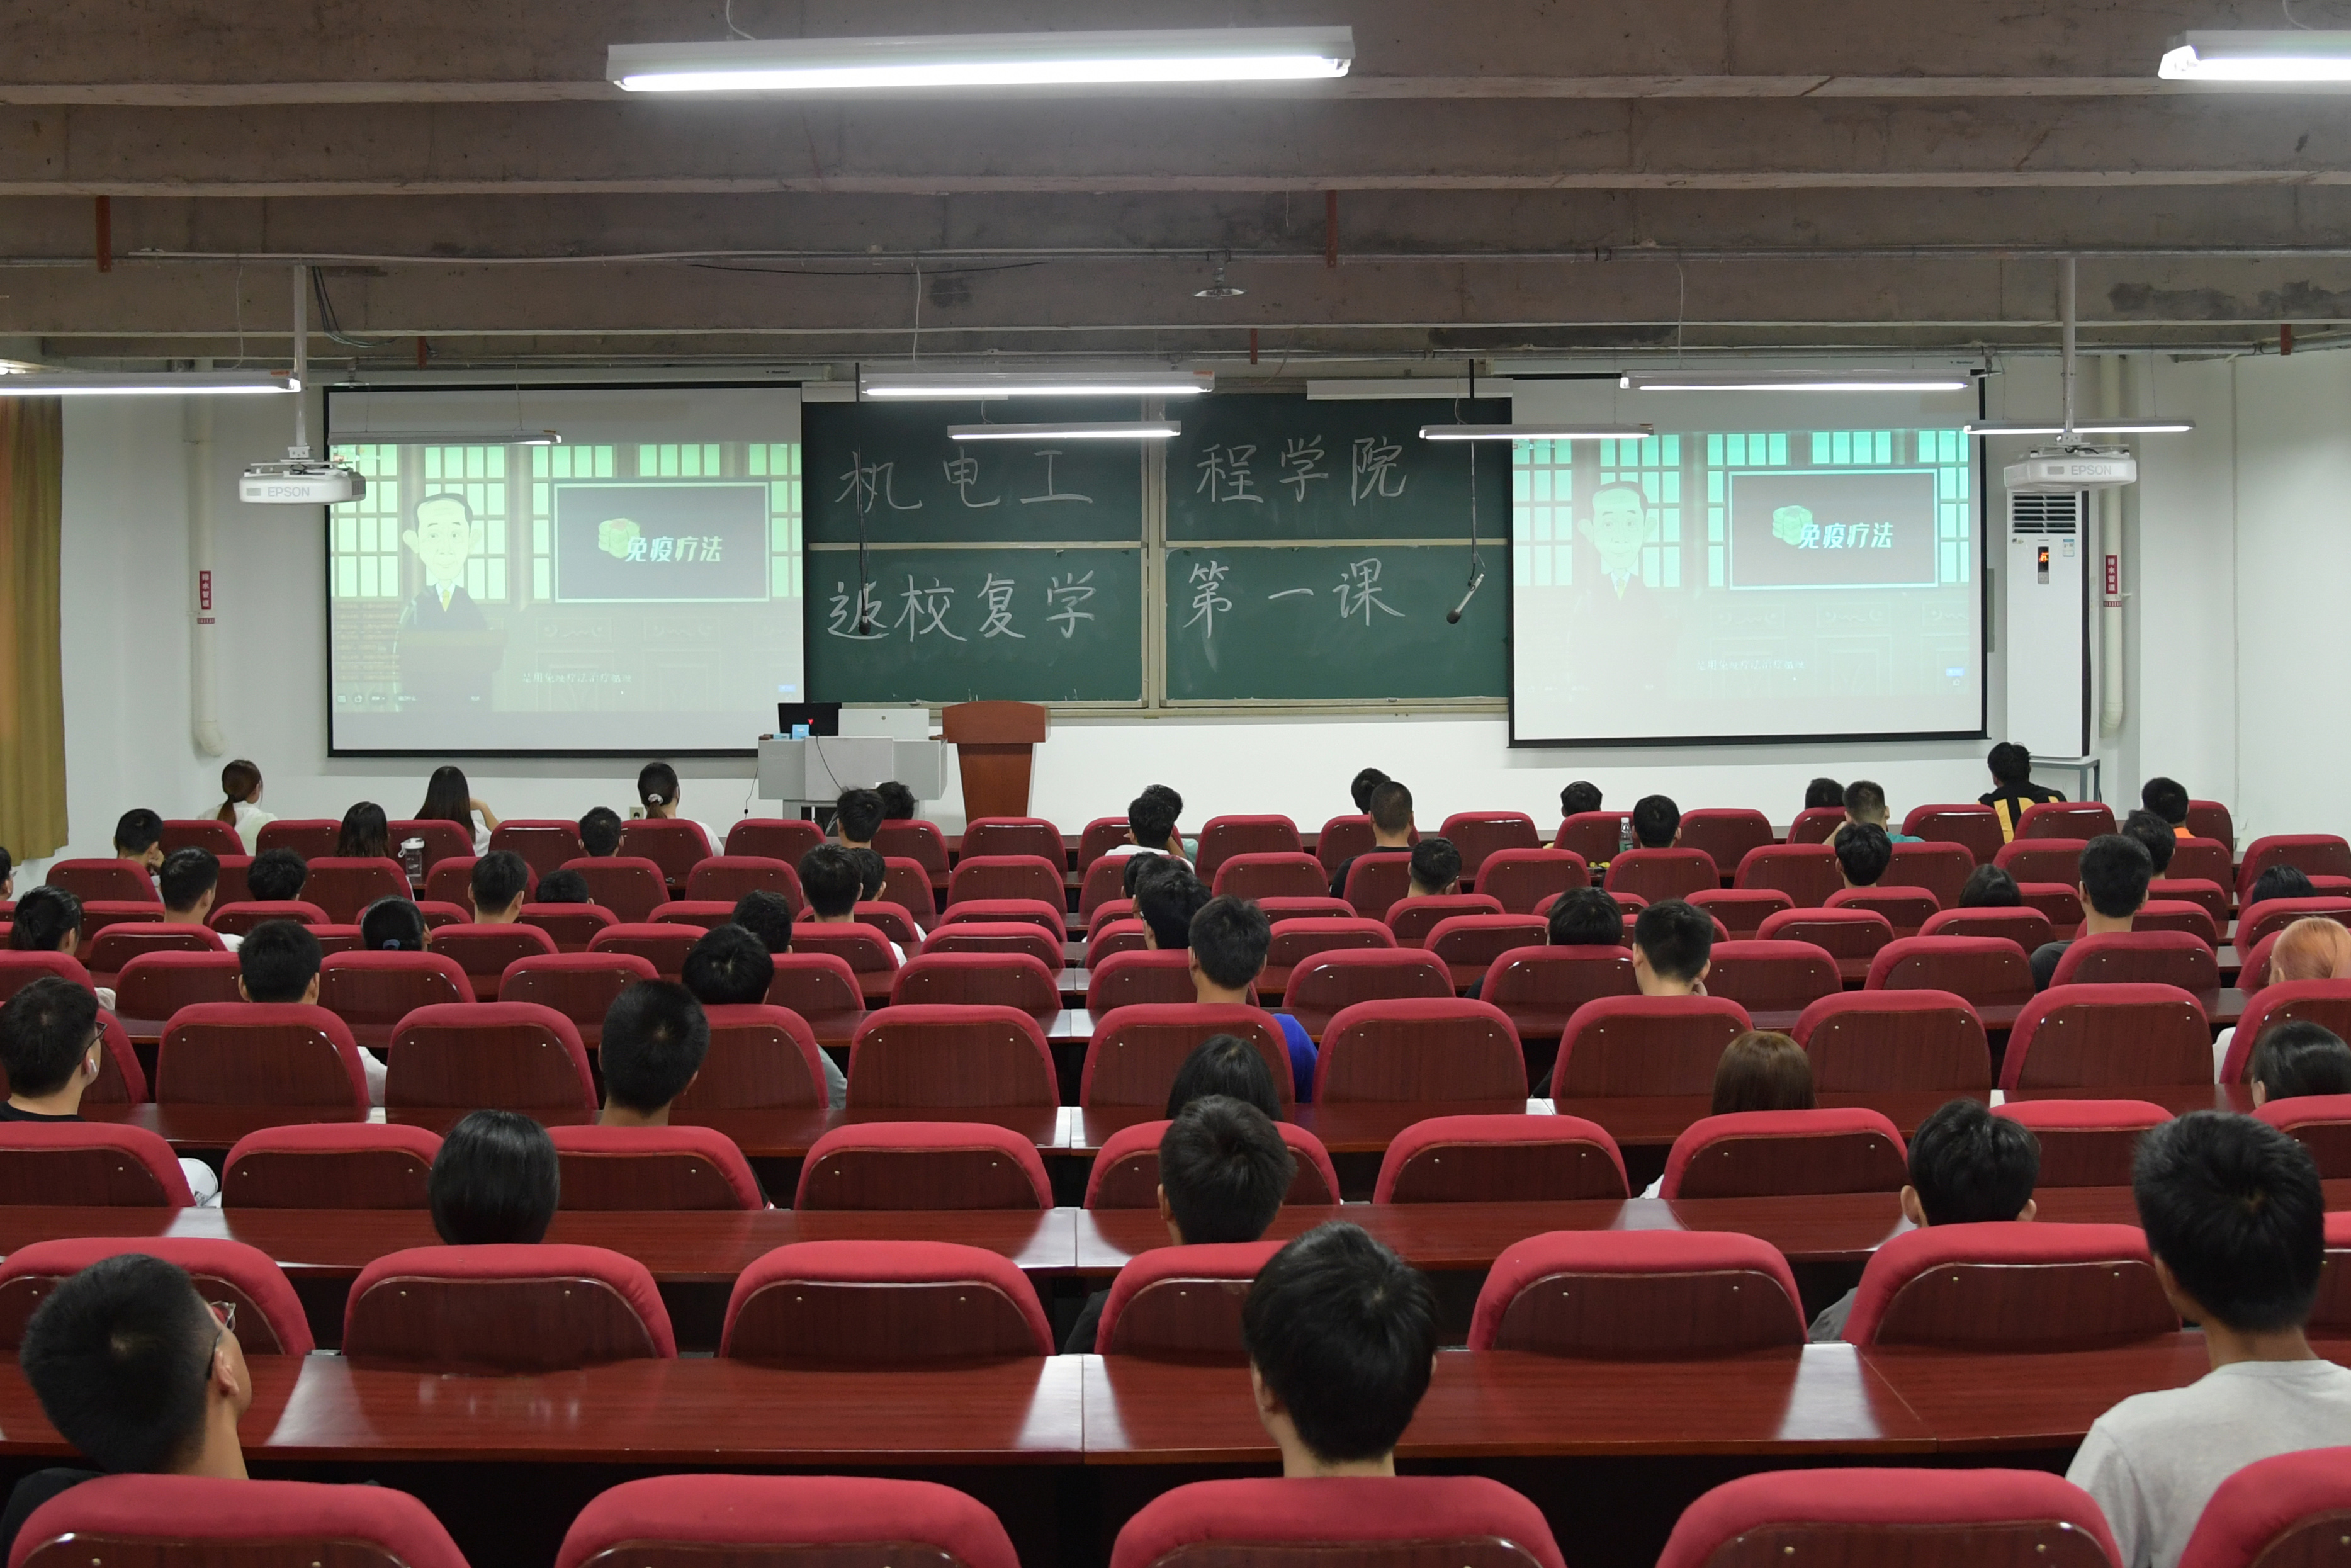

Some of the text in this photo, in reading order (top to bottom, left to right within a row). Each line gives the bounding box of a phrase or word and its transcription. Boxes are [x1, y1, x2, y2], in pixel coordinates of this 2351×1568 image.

[2071, 465, 2112, 475] EPSON
[268, 487, 310, 497] EPSON
[1797, 522, 1893, 549] 免疫疗法
[624, 536, 723, 562] 免疫疗法
[827, 558, 1406, 642] 返校复学 第一课
